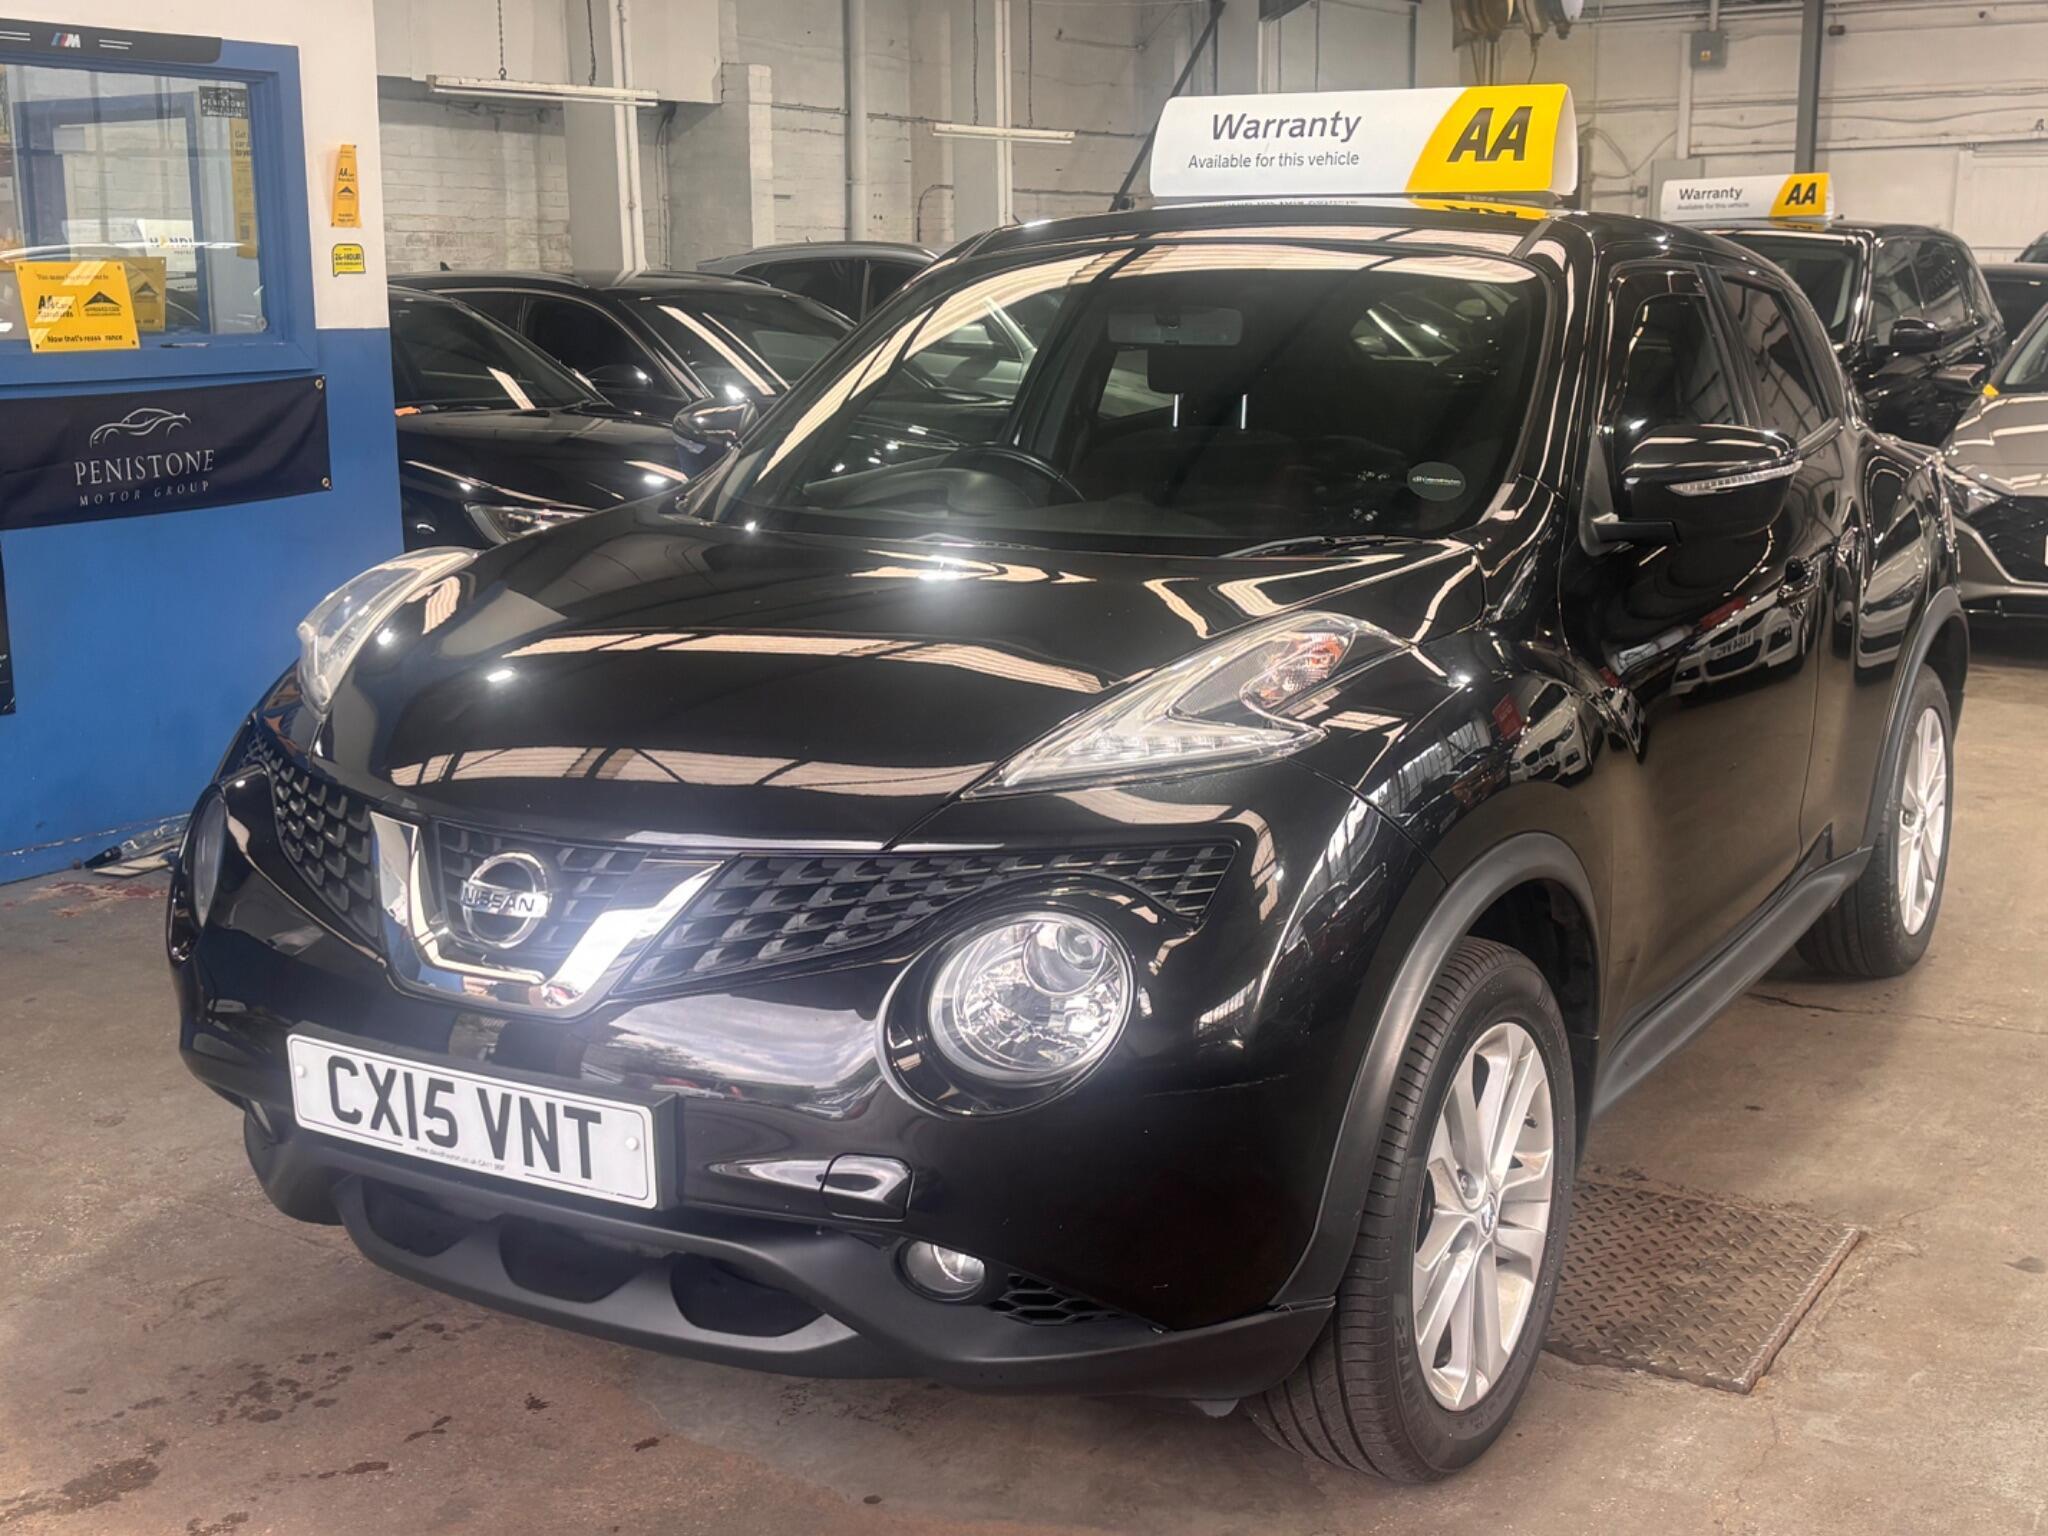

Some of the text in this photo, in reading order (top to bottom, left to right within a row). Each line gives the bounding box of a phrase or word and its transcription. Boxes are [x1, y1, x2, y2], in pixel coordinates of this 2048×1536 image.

[1211, 111, 1362, 142] Warranty
[1446, 106, 1533, 163] AA
[1188, 151, 1359, 169] Available for this vehicle
[1679, 187, 1743, 201] Warranty
[1785, 182, 1817, 205] AA
[64, 334, 83, 342] that's
[74, 449, 215, 486] PENISTONE
[79, 480, 210, 507] MOTOR GROUP
[327, 1056, 602, 1180] CX15 VNT
